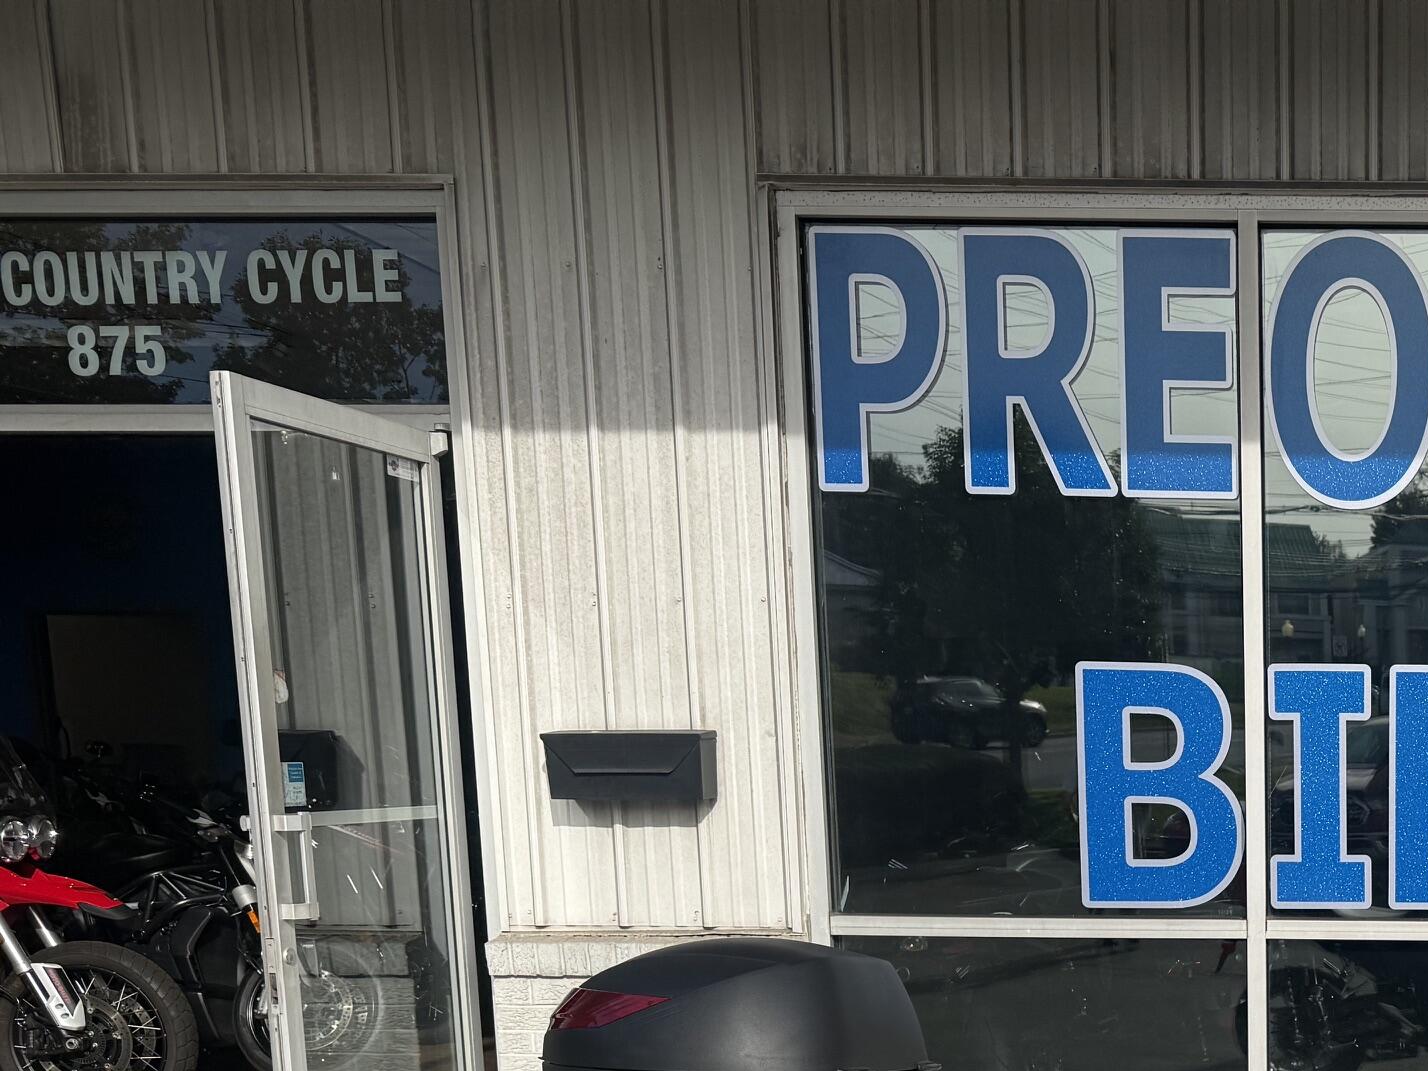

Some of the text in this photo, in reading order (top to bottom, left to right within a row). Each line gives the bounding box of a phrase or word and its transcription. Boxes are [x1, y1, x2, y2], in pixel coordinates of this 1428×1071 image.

[0, 248, 402, 306] COUNTRY CYCLE
[67, 325, 167, 376] 875
